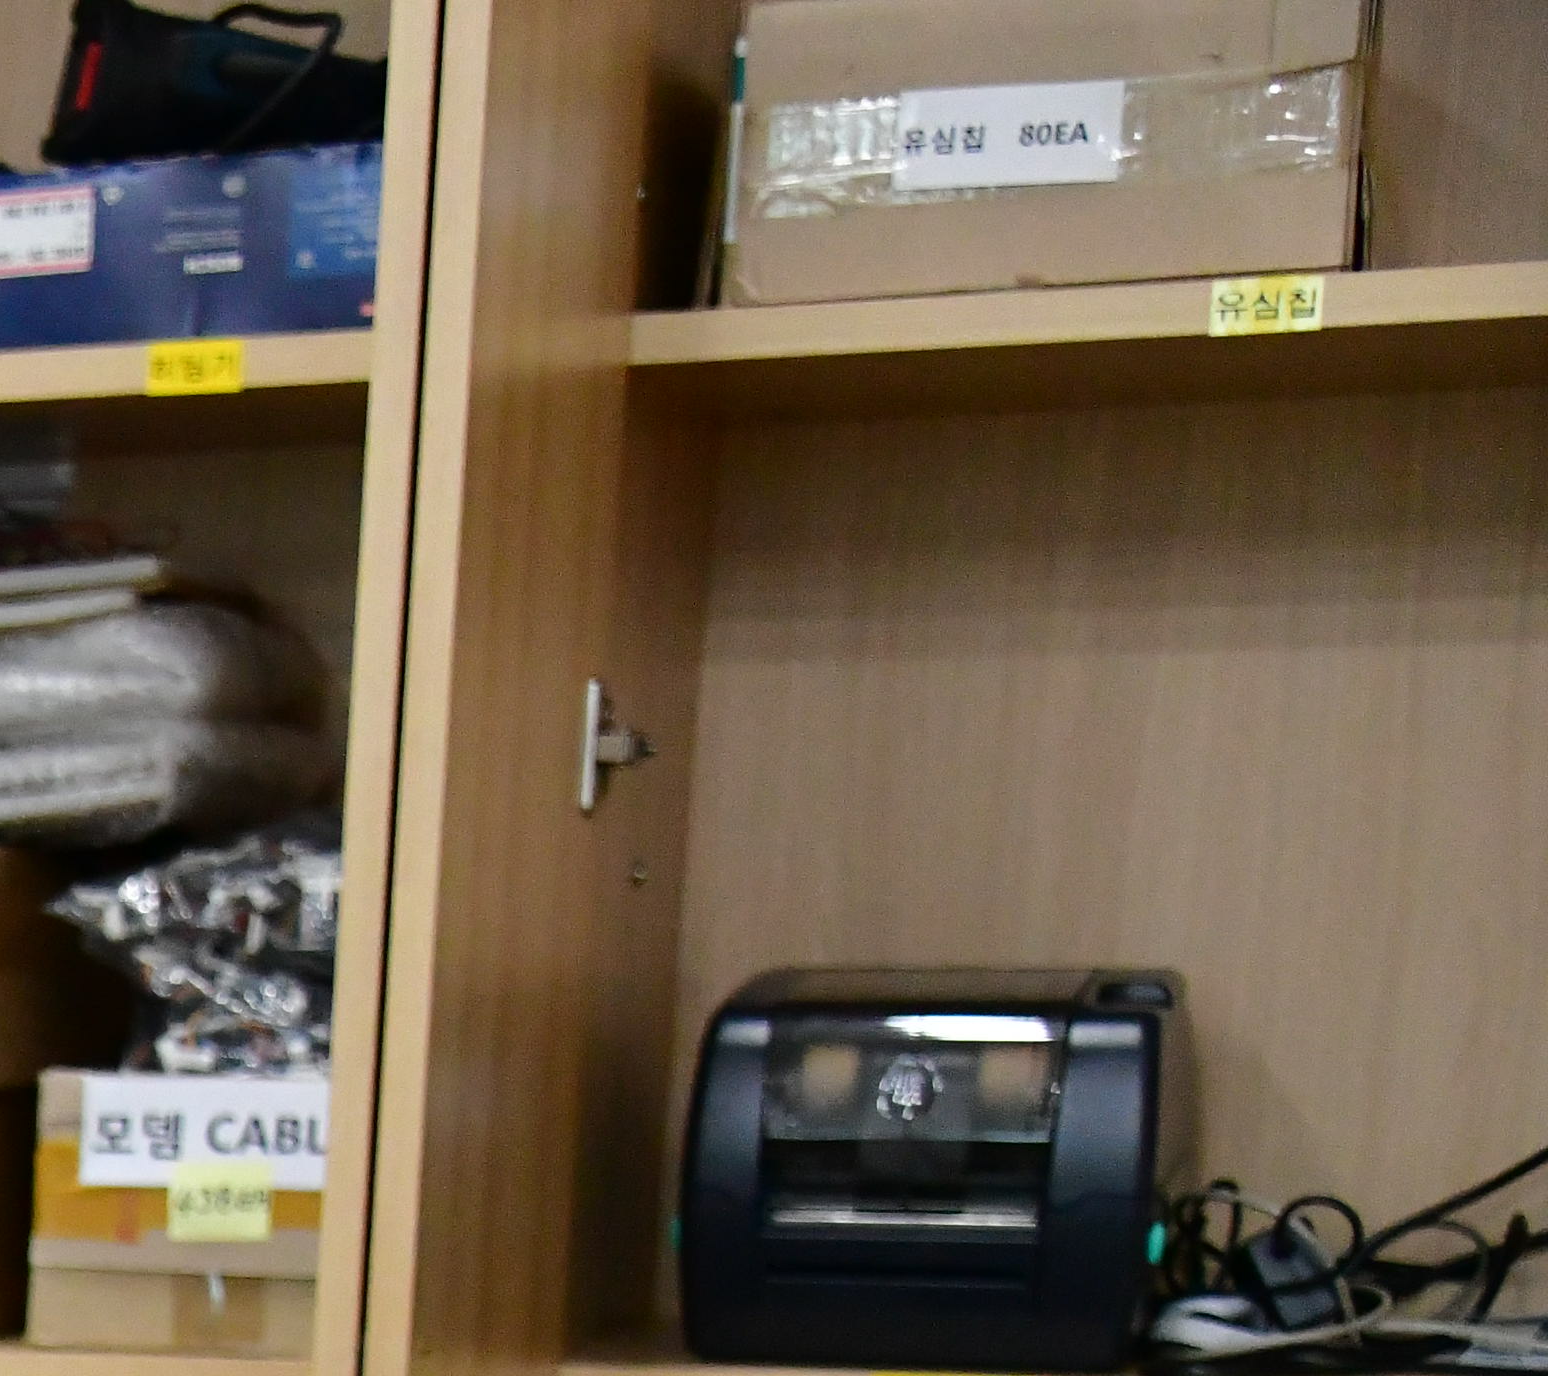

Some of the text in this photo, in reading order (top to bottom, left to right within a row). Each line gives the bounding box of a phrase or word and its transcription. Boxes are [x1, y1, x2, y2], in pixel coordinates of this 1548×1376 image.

[903, 120, 1090, 156] 유심칩 80EA
[1215, 288, 1317, 321] 유심칩
[91, 1113, 181, 1161] 모뎀
